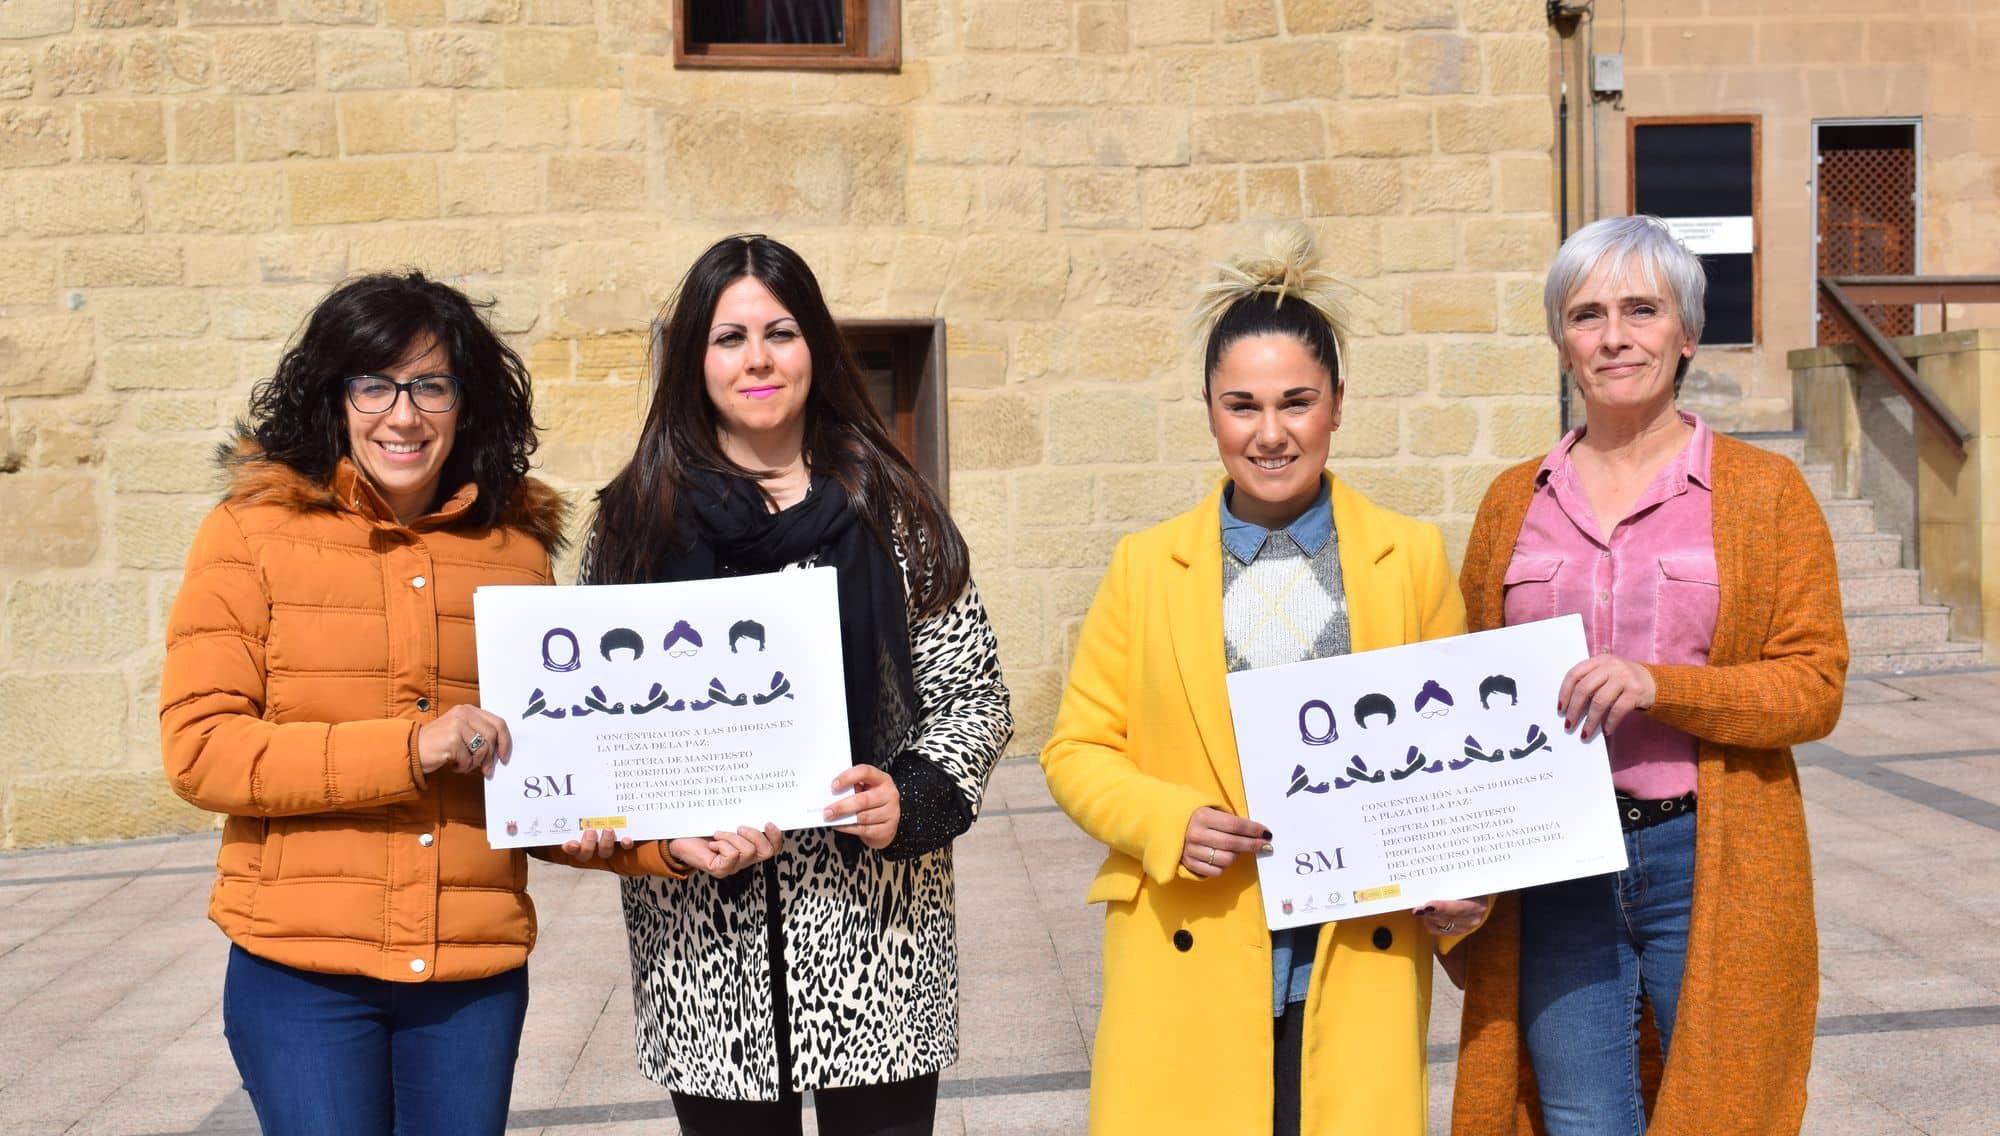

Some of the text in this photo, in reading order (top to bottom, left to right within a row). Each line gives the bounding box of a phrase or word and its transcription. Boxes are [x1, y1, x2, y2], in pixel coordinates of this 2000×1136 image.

[596, 729, 691, 741] CONCENTRACIÓN
[704, 727, 724, 735] LAS
[727, 725, 737, 733] 19
[740, 722, 777, 732] HORAS
[779, 720, 794, 728] EN
[614, 743, 648, 751] PLAZA
[652, 741, 667, 749] DE
[669, 741, 683, 749] LA
[613, 751, 753, 767] LECTURA DE MANIFIESTO
[614, 762, 749, 778] RECORRIDO AMENIZADO
[523, 773, 576, 798] 8M
[615, 769, 796, 790] PROCLAMACIÓN DEL GANADOR/A
[616, 793, 638, 801] DEL
[641, 789, 701, 799] CONCURSO
[704, 787, 719, 796] DE
[722, 784, 775, 794] MURALES
[1361, 789, 1452, 811] CONCENTRACIÓN
[1465, 784, 1485, 793] LAS
[1488, 782, 1497, 790] 19
[1500, 775, 1537, 788] HORAS
[1540, 772, 1554, 780] EN
[618, 797, 742, 813] IES CIUDAD DE HARO
[1364, 815, 1377, 823] LA
[1380, 808, 1413, 821] PLAZA
[1415, 806, 1429, 814] DE
[1432, 803, 1445, 811] LA
[1381, 822, 1429, 835] LECTURA
[1449, 805, 1516, 824] MANIFIESTO
[1383, 817, 1514, 847] RECORRIDO AMENIZADO
[1385, 821, 1561, 859] PROCLAMACIÓN DEL GANADOR/A
[1295, 847, 1347, 875] 8M
[1387, 833, 1565, 870] DEL CONCURSO DE MURALES DEL
[1389, 853, 1511, 881] IES CIUDAD DE HARO
